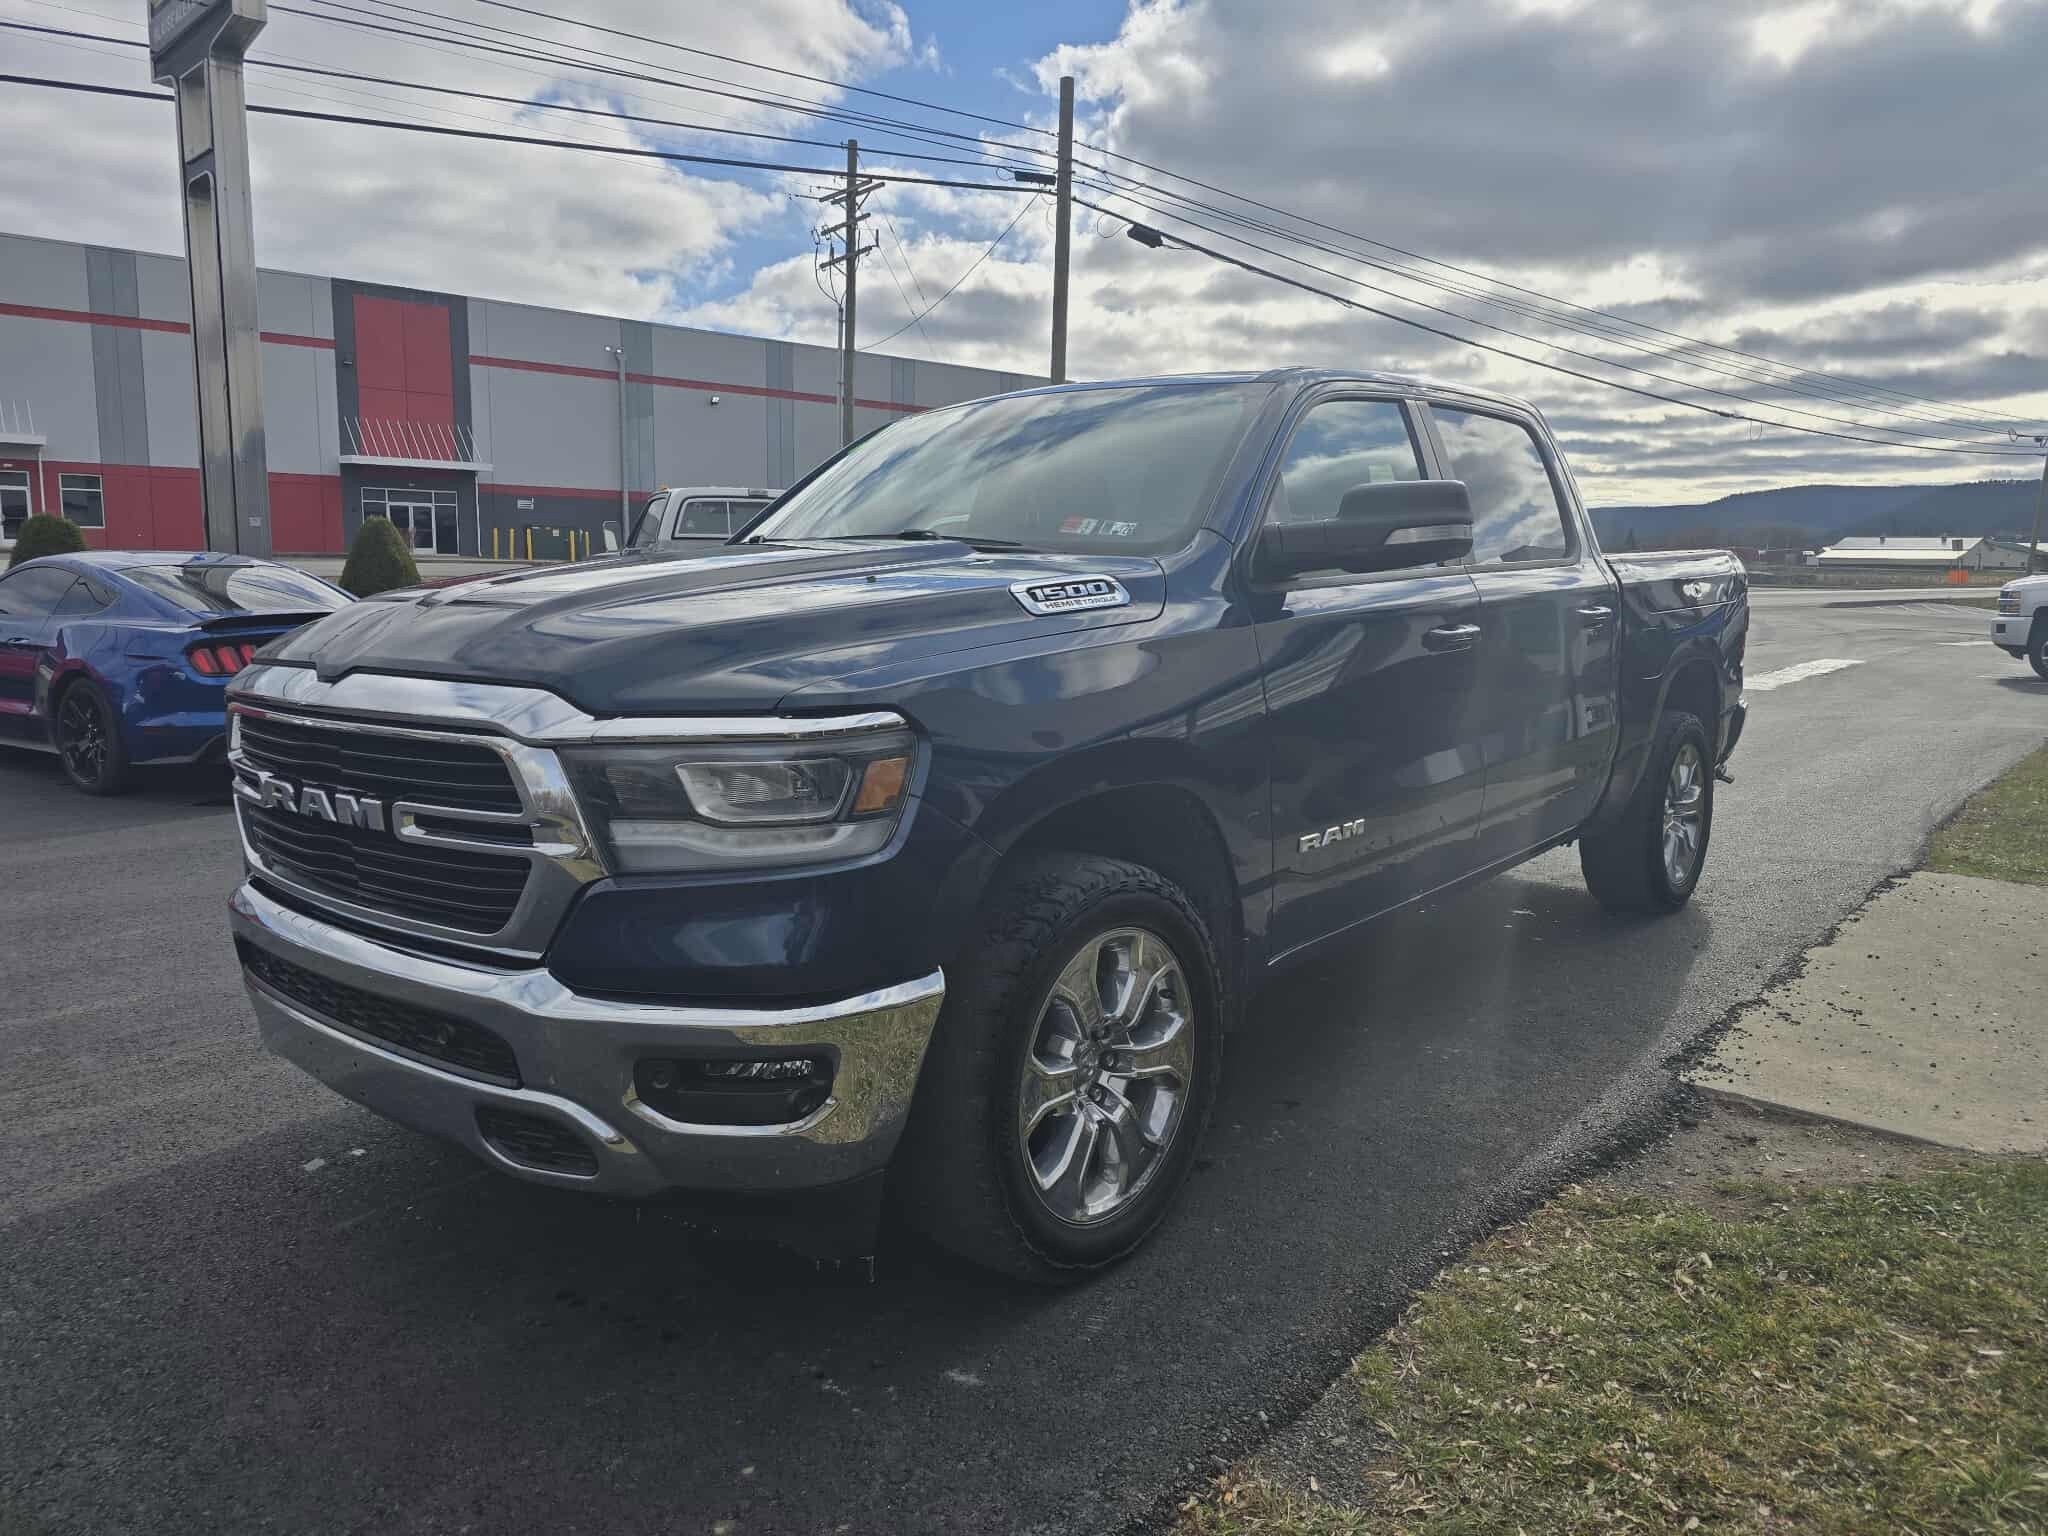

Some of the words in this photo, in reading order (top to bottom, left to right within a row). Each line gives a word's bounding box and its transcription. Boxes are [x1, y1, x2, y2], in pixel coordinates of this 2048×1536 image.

[1030, 581, 1109, 600] 1500
[1044, 600, 1073, 609] HEMI
[260, 776, 386, 832] RAM
[1299, 818, 1365, 853] RAM
